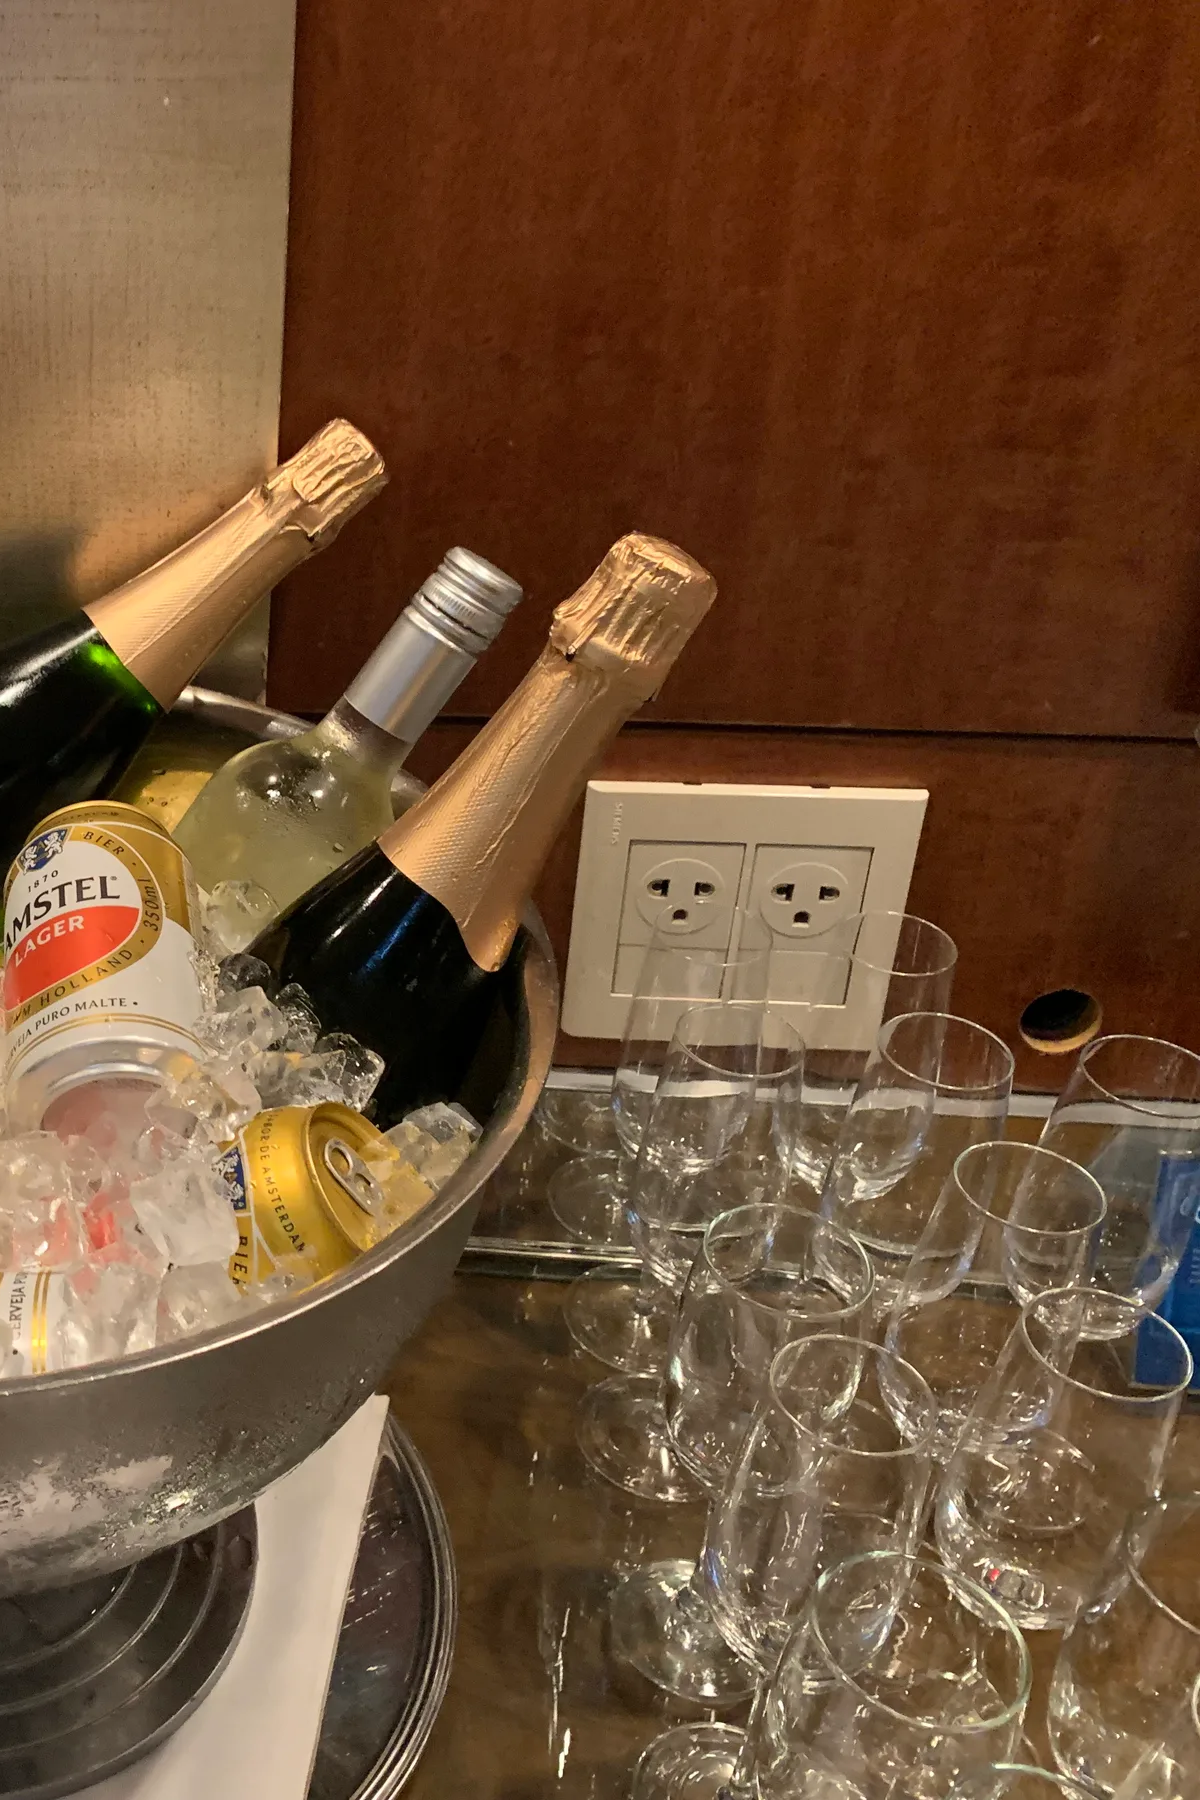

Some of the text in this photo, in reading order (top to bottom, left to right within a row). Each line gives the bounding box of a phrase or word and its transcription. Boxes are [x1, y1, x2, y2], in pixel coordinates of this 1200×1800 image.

[83, 831, 125, 855] BIER
[28, 870, 58, 893] 1870
[137, 878, 160, 932] 350ml
[15, 914, 84, 968] LAGER
[39, 949, 133, 1006] HOLLAND
[35, 1006, 70, 1031] PURO
[75, 997, 128, 1012] MALTE
[260, 1145, 271, 1161] DE
